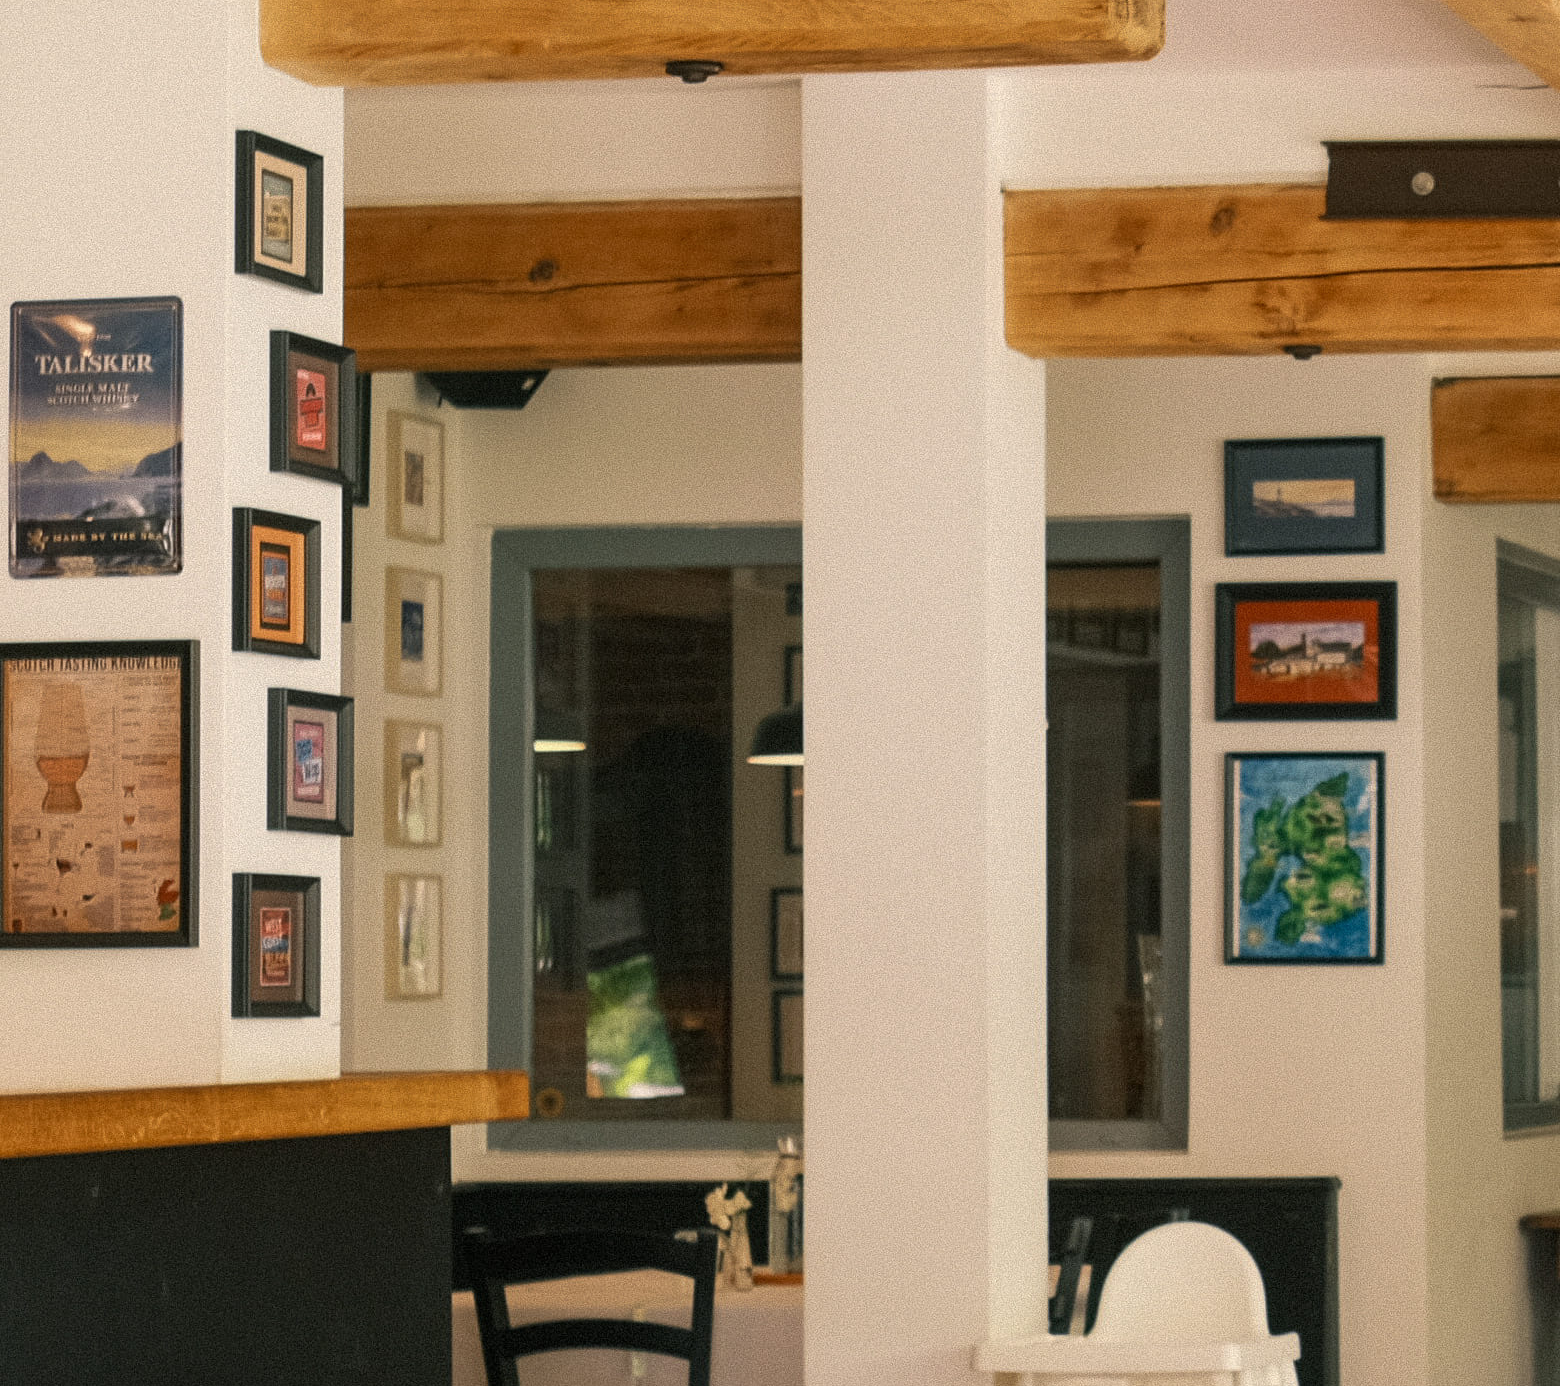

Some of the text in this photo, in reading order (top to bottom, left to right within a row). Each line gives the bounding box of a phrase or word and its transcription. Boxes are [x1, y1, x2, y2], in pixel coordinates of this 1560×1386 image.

[34, 353, 156, 376] TALISKER
[55, 381, 131, 394] SINGLE MALT
[47, 394, 90, 406] SCOTCH
[52, 532, 87, 543] MADE
[90, 532, 106, 542] BY
[112, 531, 137, 541] THE
[8, 659, 55, 673] SCOTCH
[59, 658, 108, 672] TASTING
